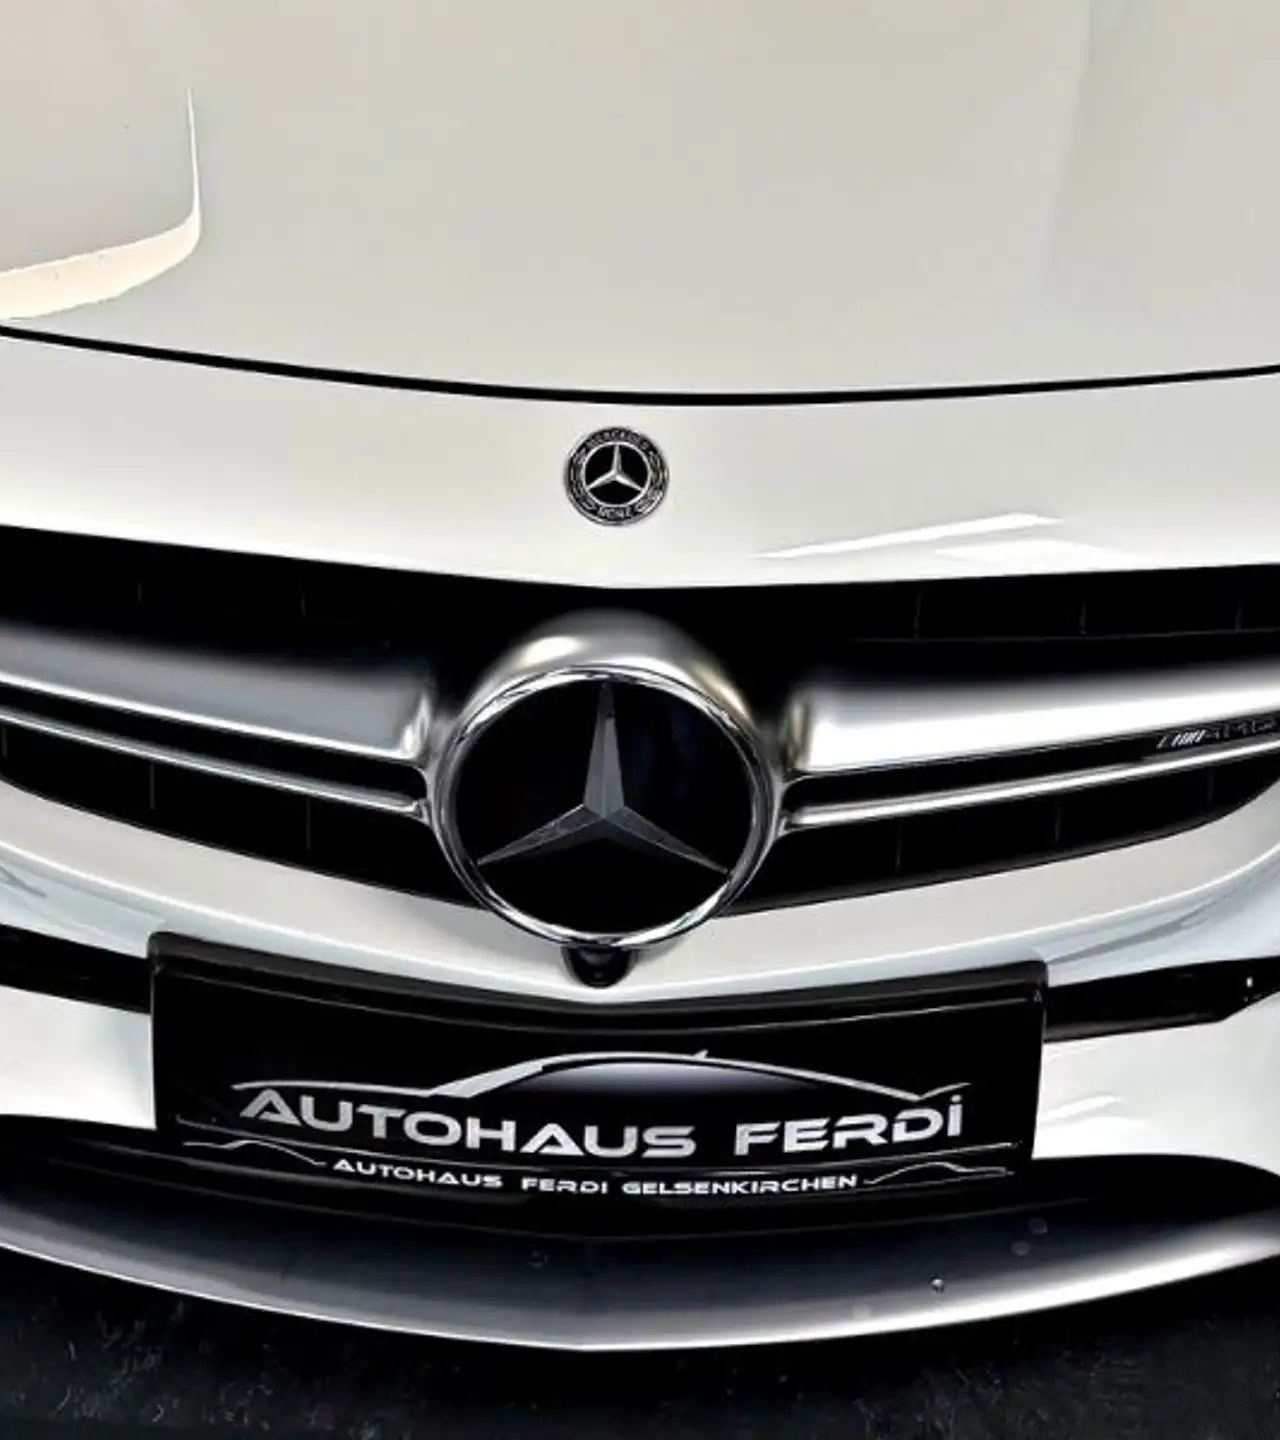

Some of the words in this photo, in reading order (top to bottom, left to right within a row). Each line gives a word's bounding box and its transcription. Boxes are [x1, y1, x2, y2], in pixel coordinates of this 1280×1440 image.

[239, 1087, 696, 1158] AUTOHAUS
[333, 1158, 503, 1189] AUTOHAUS
[521, 1177, 608, 1195] FERDI
[622, 1174, 858, 1196] GELSENKIRCHEN
